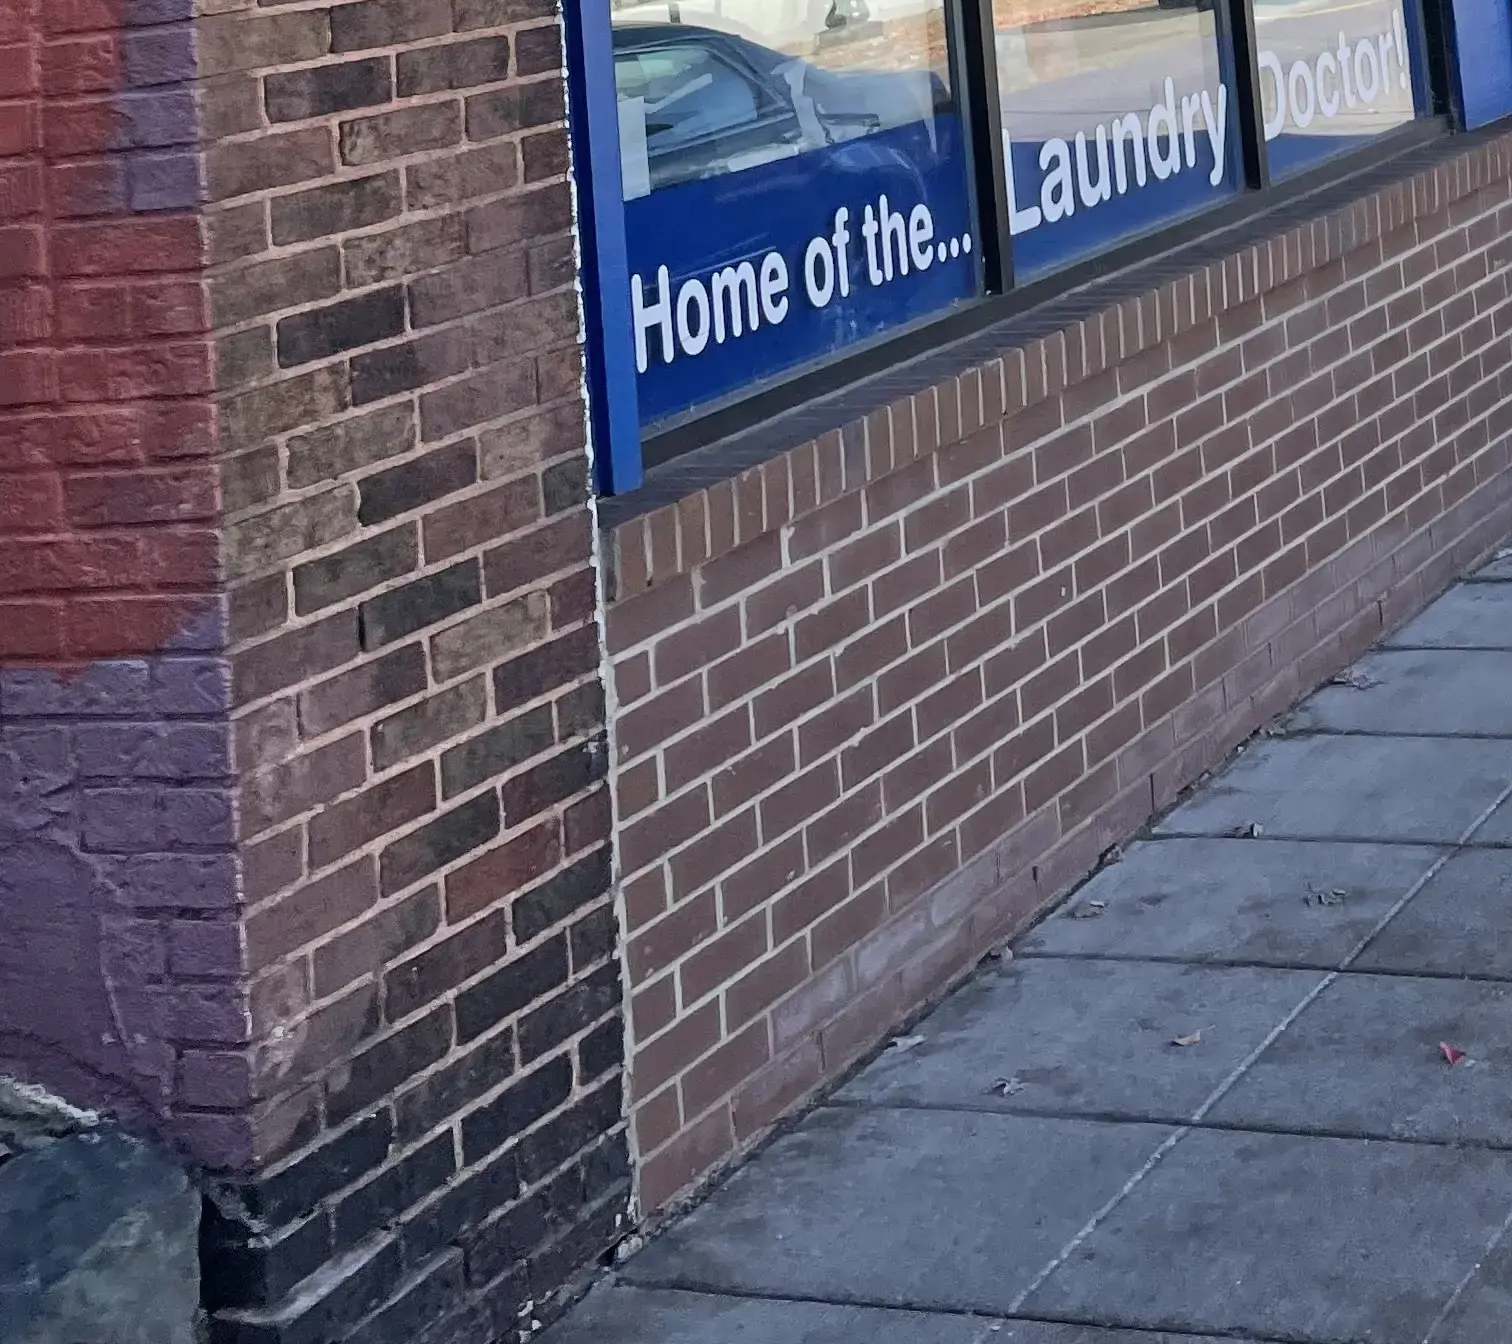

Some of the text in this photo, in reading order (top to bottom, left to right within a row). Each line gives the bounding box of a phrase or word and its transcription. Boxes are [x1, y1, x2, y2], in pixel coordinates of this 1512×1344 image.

[1001, 8, 1408, 236] Laundry Doctor!
[631, 193, 973, 374] Home of the...
